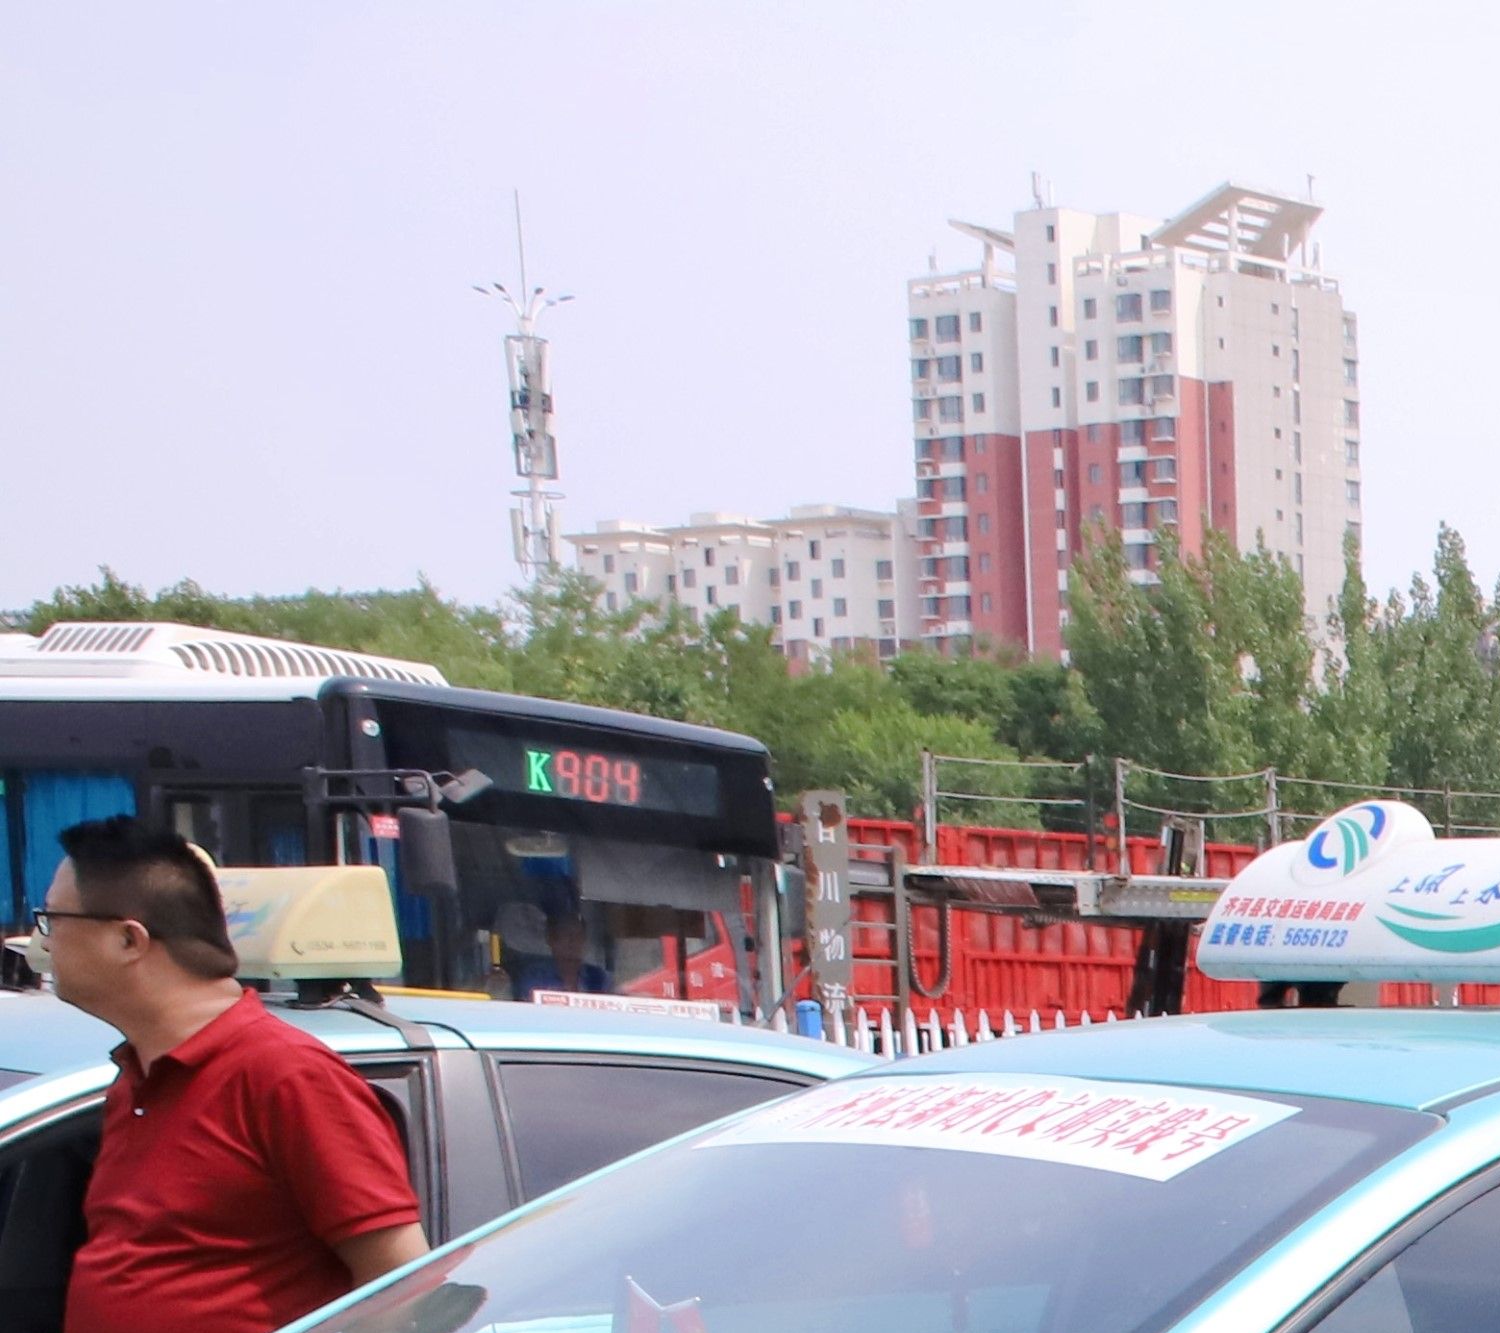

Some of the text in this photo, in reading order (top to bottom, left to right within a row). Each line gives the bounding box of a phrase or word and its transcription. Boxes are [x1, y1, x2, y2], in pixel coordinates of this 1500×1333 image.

[526, 750, 640, 804] K904
[1222, 897, 1366, 922] 齐河县交通运输局监制
